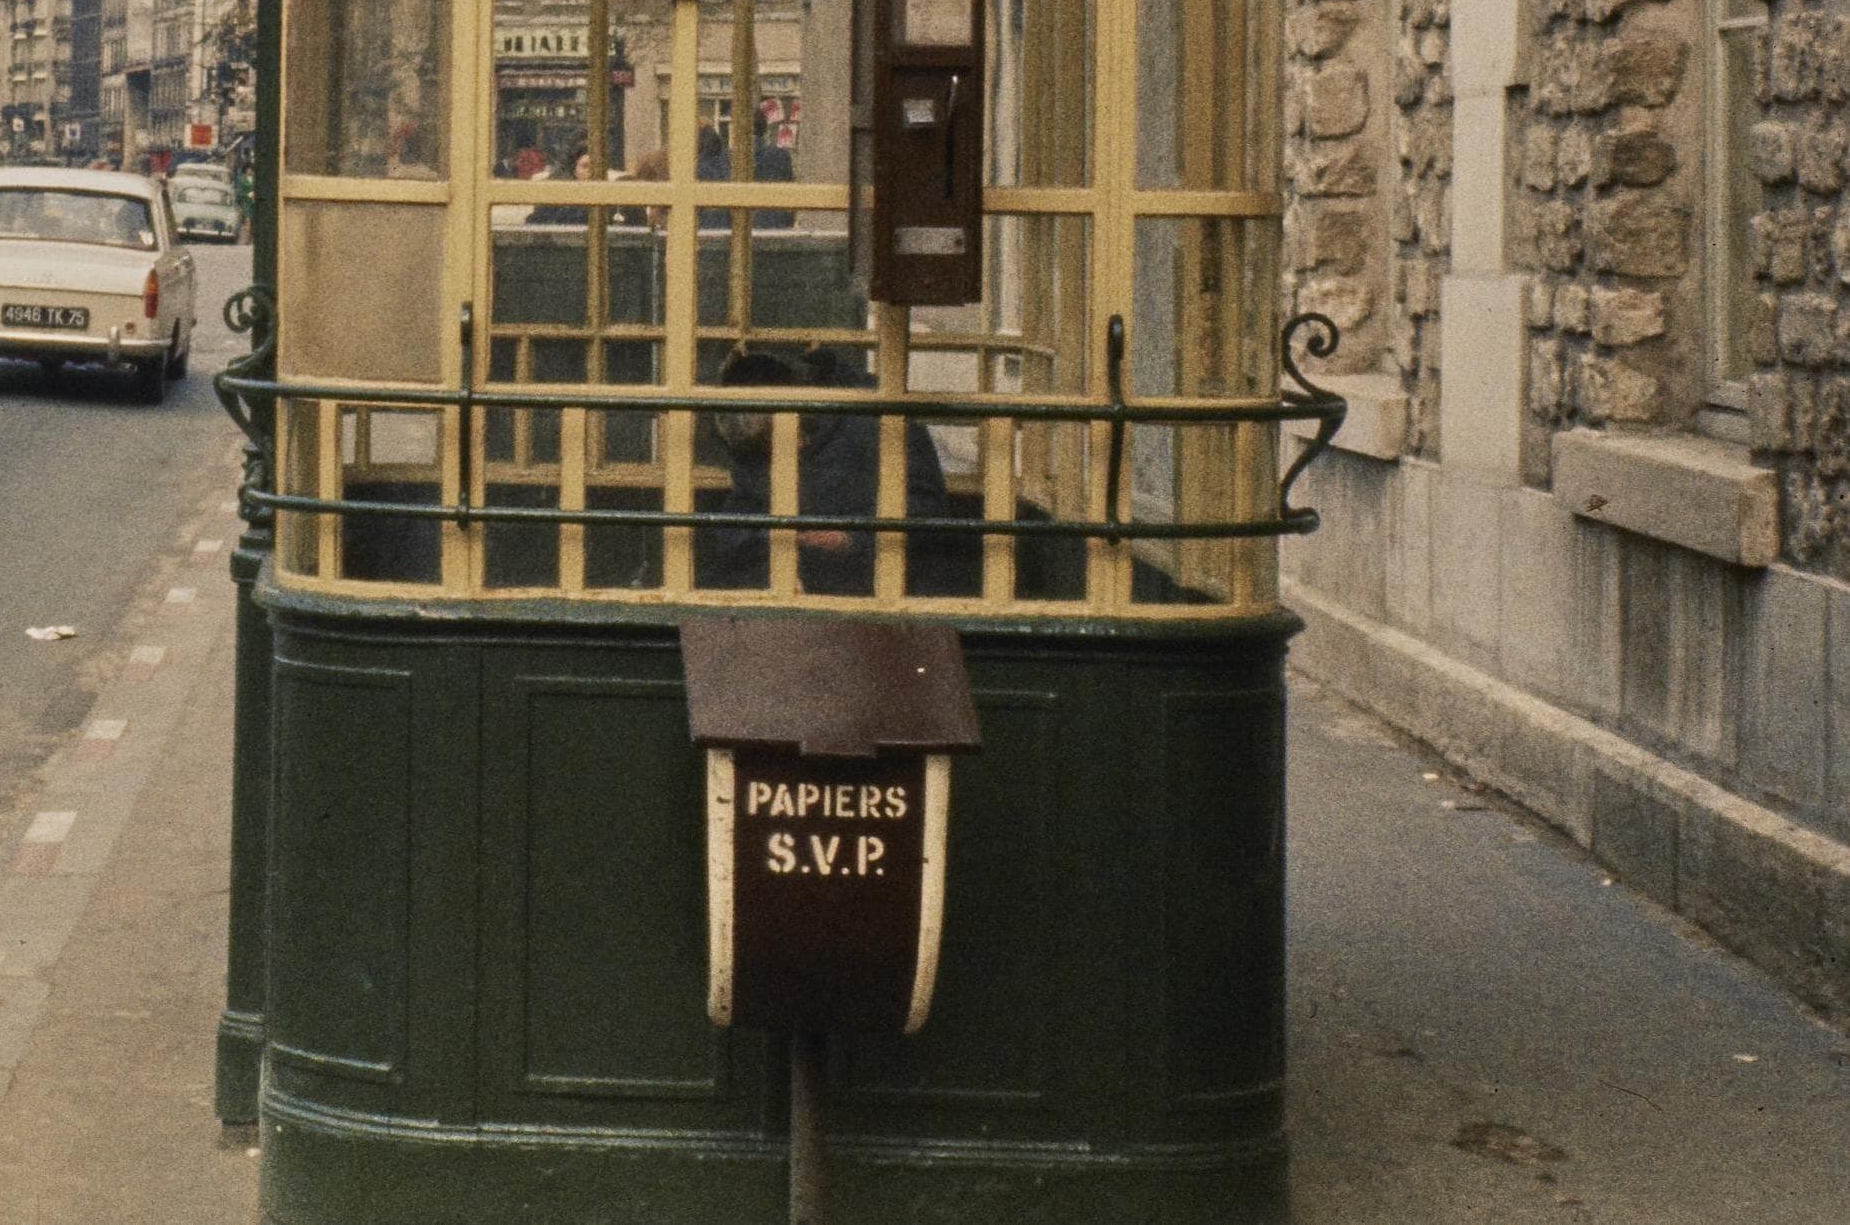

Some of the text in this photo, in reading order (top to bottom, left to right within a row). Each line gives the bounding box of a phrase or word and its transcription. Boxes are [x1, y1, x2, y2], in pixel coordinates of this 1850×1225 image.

[68, 309, 85, 326] 75
[747, 781, 907, 818] PAPIERS
[767, 832, 886, 875] S.V.P.
